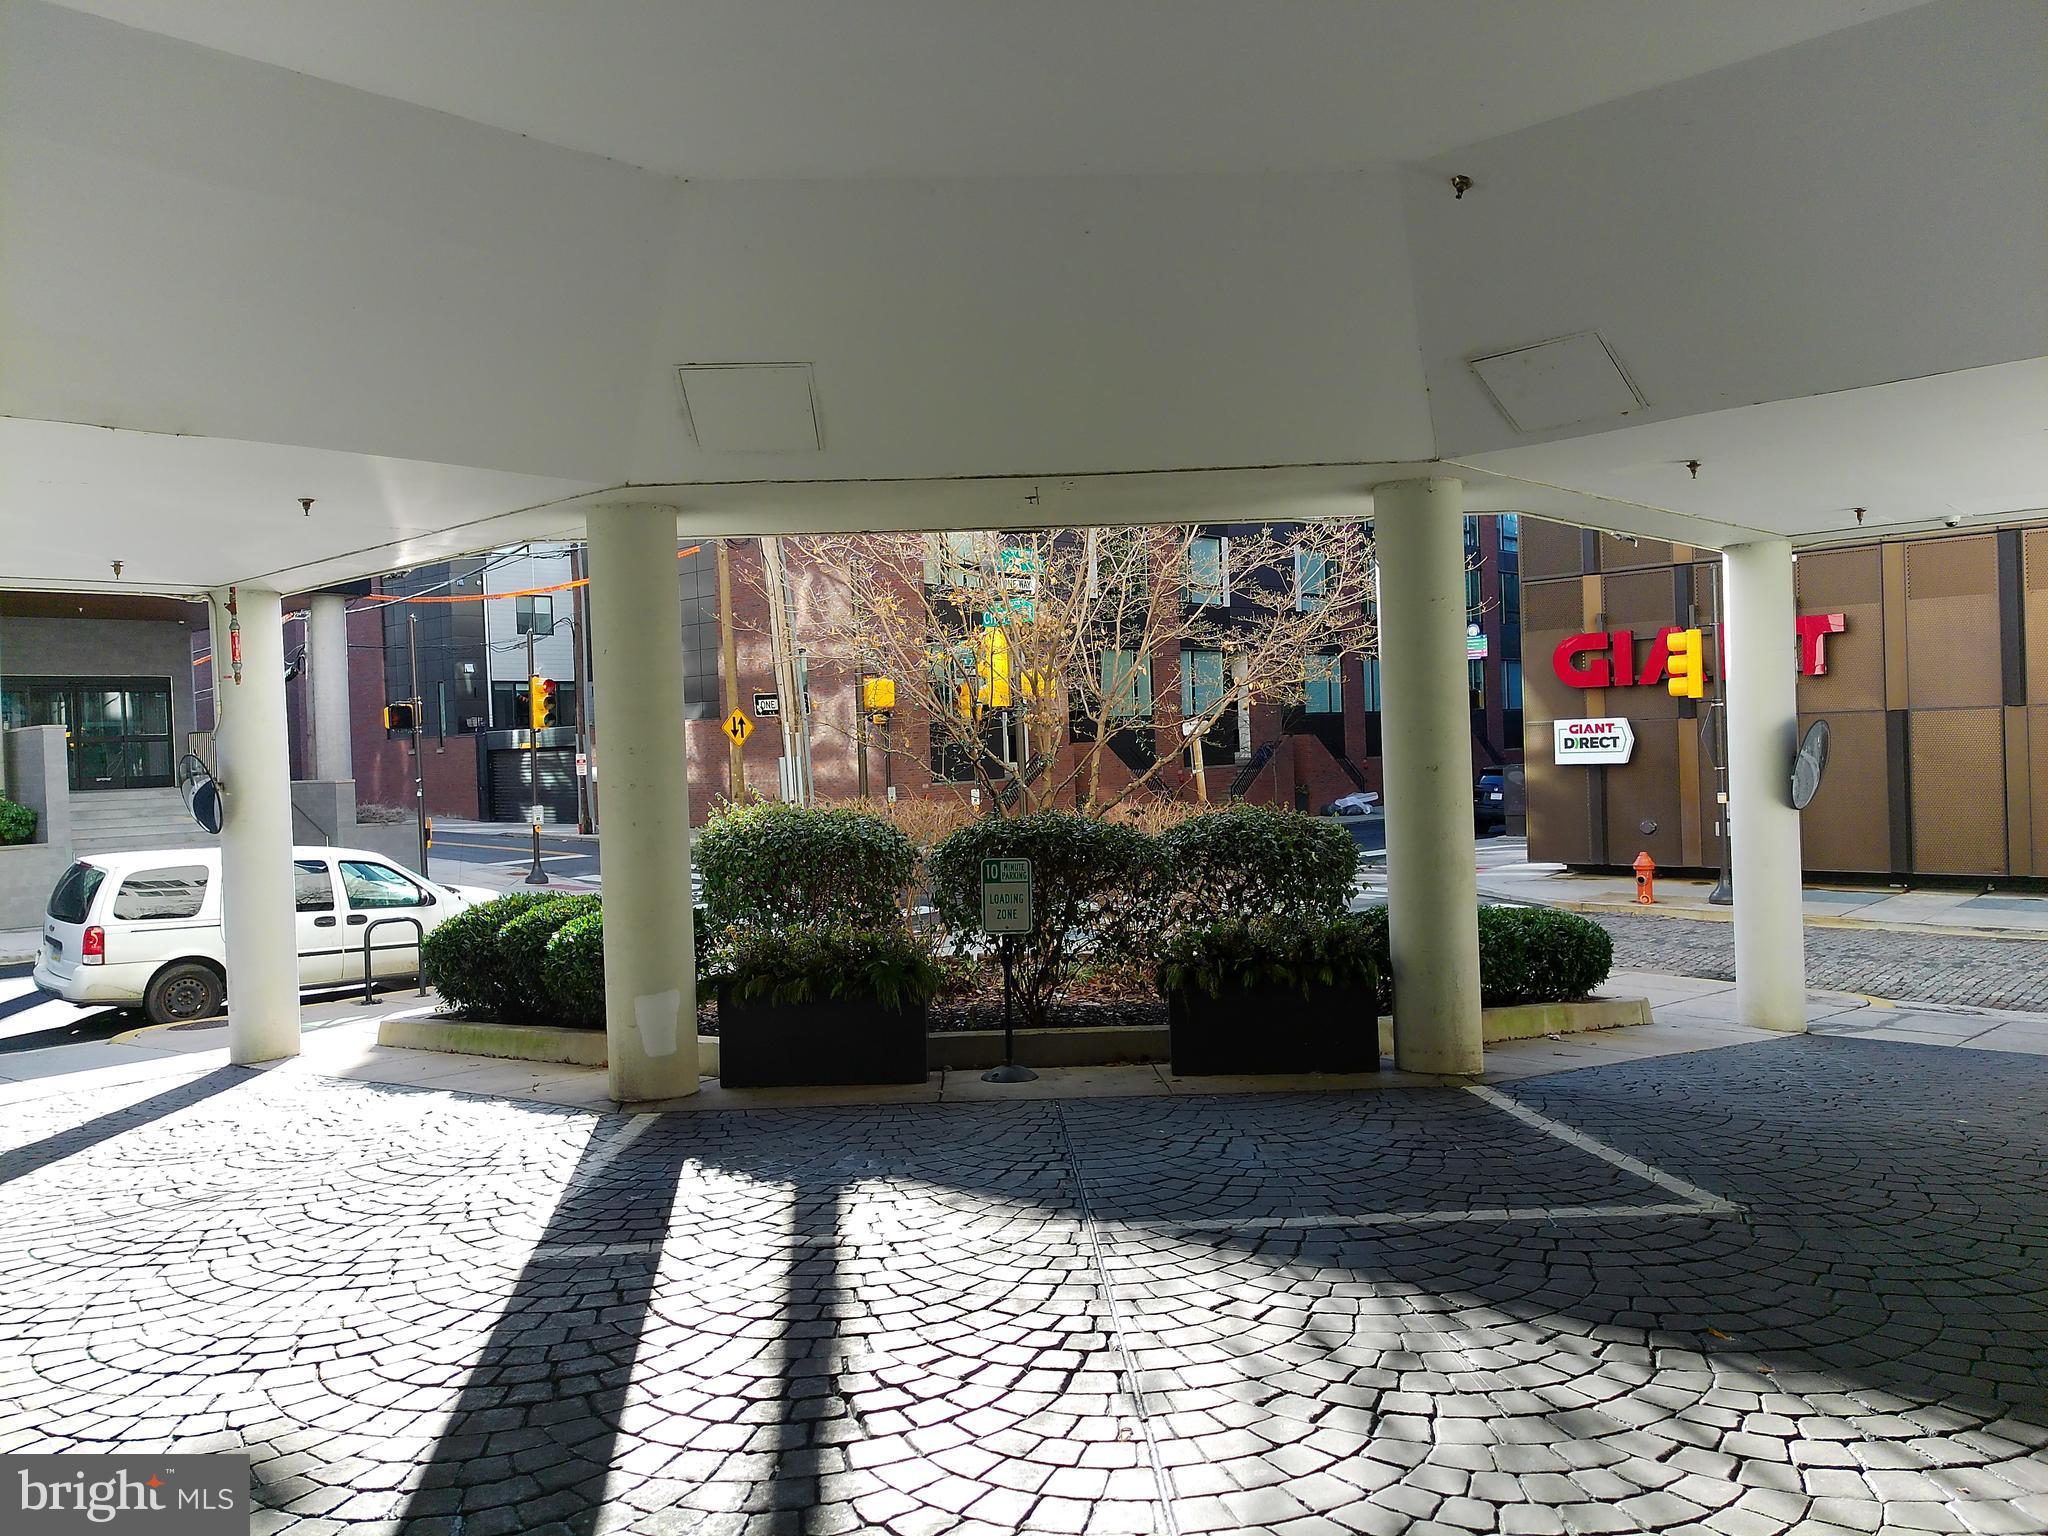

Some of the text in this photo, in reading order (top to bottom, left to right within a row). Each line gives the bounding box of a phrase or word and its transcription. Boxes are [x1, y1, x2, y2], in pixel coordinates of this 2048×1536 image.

[1018, 579, 1032, 589] WAY
[1553, 613, 1846, 688] GIAT
[760, 700, 776, 709] ONE
[1569, 722, 1615, 735] GIANT
[1563, 735, 1620, 750] DIRECT
[985, 864, 998, 879] 10
[1003, 862, 1025, 872] MINUTE
[1001, 871, 1028, 880] PARKING
[989, 893, 1024, 905] LOADING
[996, 909, 1018, 920] ZONE
